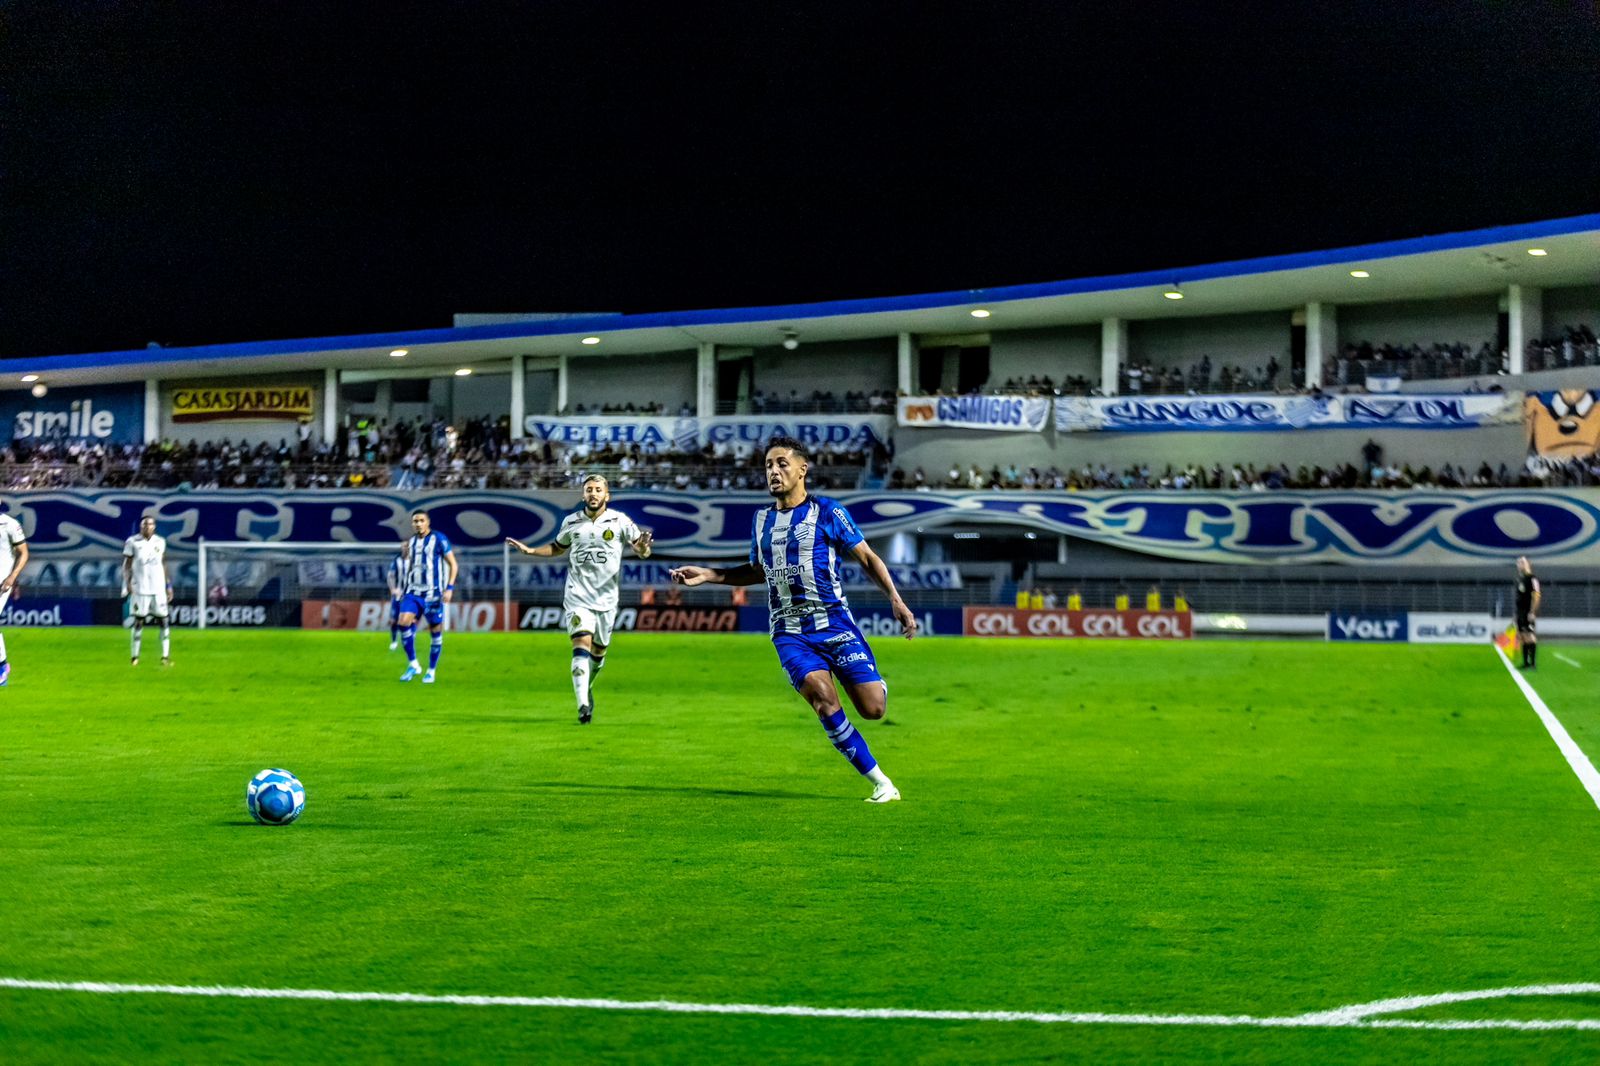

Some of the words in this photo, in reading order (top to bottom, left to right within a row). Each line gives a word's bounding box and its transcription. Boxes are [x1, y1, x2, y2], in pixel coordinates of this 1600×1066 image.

[13, 399, 114, 439] smile
[532, 421, 668, 444] VELHA
[708, 421, 880, 444] GUARDA
[0, 497, 550, 550] NTRO
[145, 606, 267, 625] YBROKERS
[637, 609, 738, 631] GANHA
[973, 613, 1020, 635] GOL
[1028, 614, 1075, 635] GOL
[1082, 614, 1129, 636] GOL
[1138, 615, 1185, 637] GOL
[1336, 615, 1400, 638] VOLT
